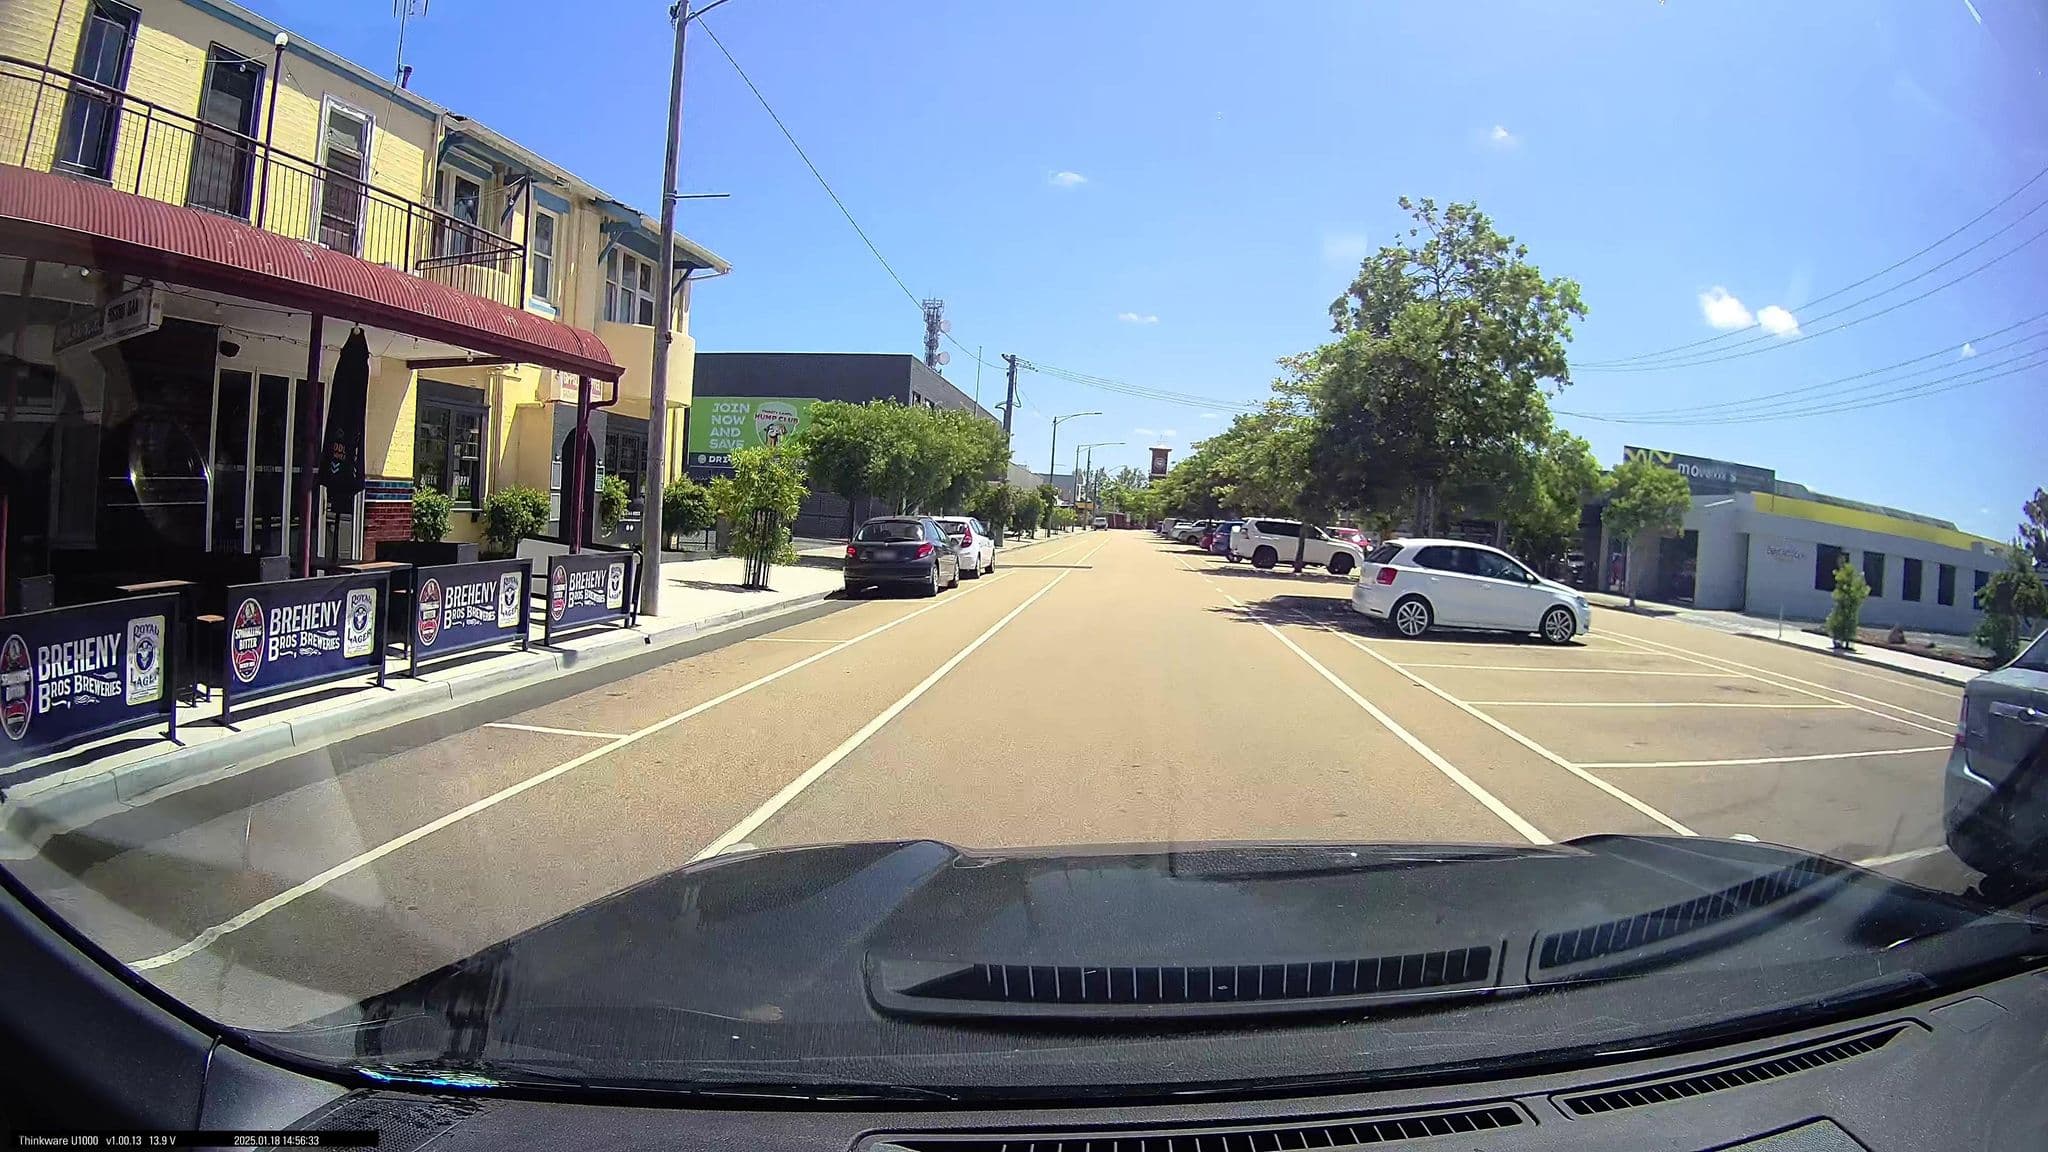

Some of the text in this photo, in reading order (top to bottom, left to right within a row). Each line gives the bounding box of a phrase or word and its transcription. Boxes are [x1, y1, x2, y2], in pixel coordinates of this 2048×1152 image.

[712, 402, 750, 414] JOIN
[712, 415, 746, 425] NOW
[710, 427, 741, 437] AND
[709, 439, 745, 449] SAVE
[569, 569, 607, 591] BREHENY
[444, 580, 498, 609] BREHENY
[270, 600, 342, 636] BREHENY
[133, 623, 160, 638] ROYAL
[348, 627, 372, 644] LAGER
[38, 632, 122, 682] BREHENY
